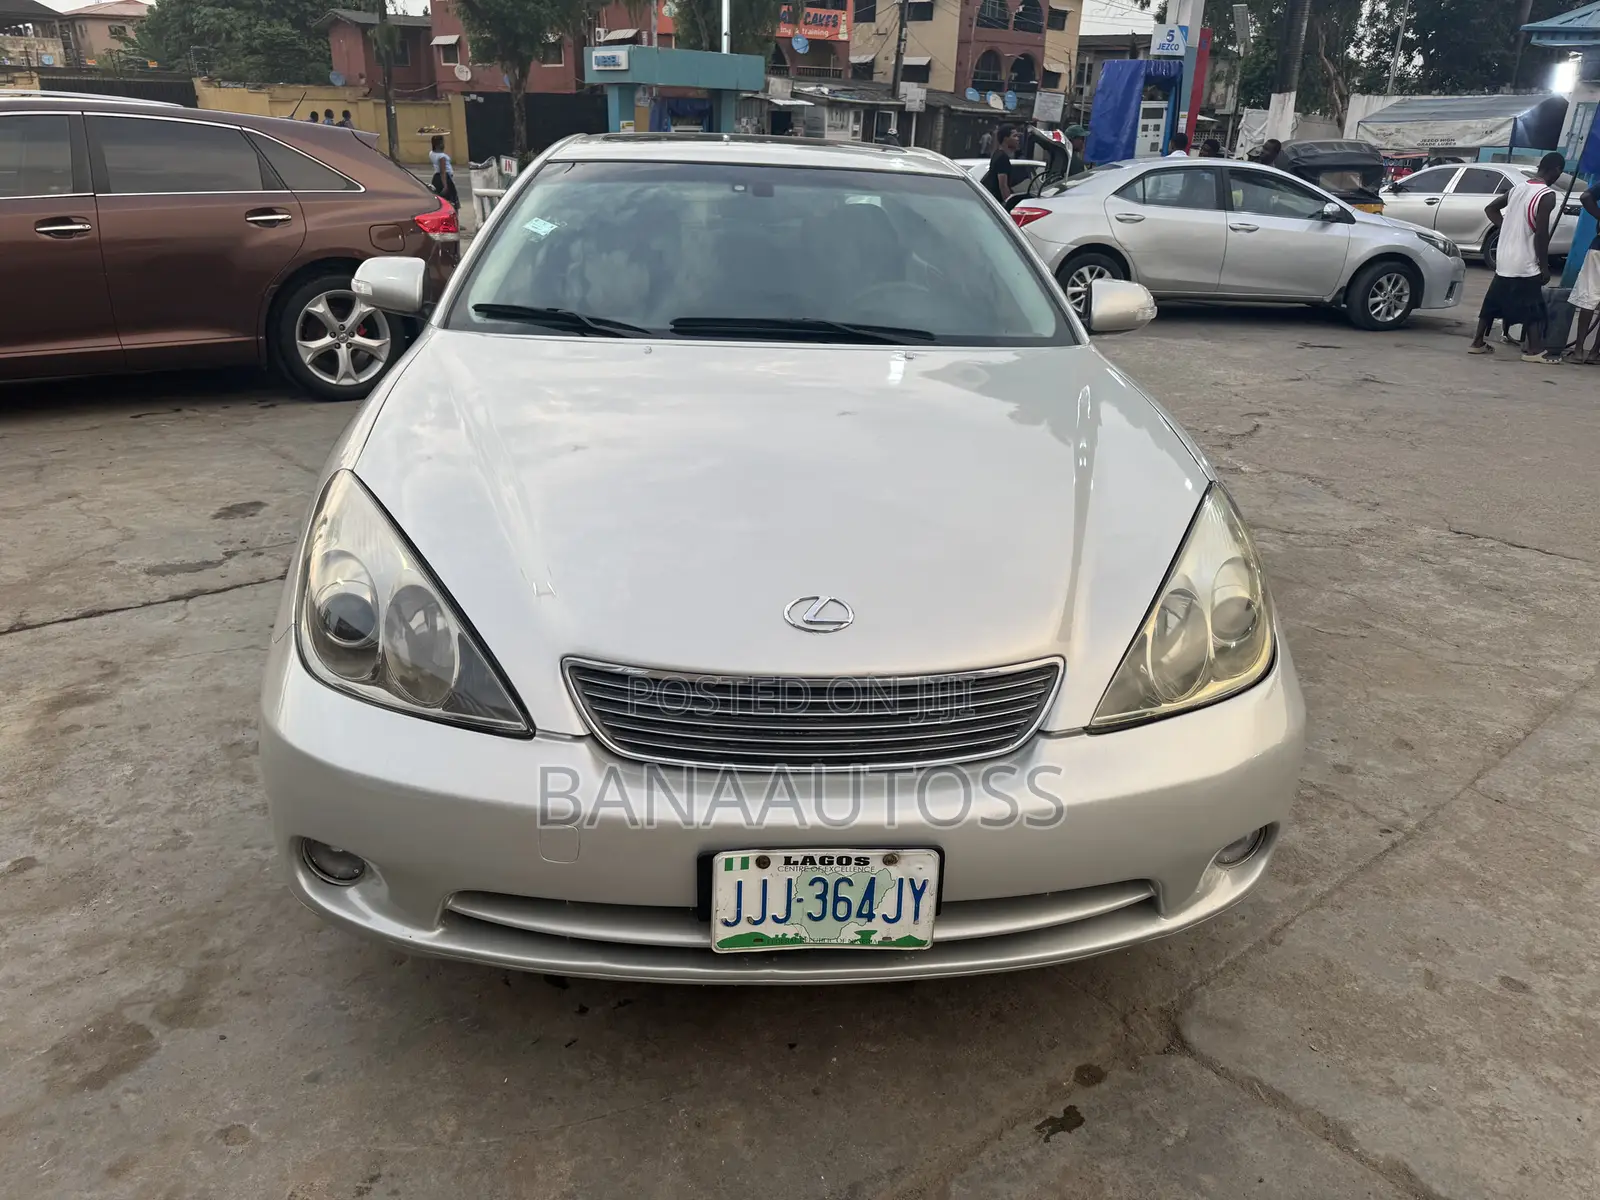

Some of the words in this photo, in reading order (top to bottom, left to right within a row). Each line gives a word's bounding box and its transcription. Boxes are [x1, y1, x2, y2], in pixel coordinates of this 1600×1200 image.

[803, 12, 838, 27] CAKES
[1166, 29, 1175, 42] 5
[1157, 43, 1179, 51] JEZCO
[504, 159, 513, 172] IN
[783, 855, 871, 866] LAGOS
[721, 876, 929, 927] JJJ-364JY
